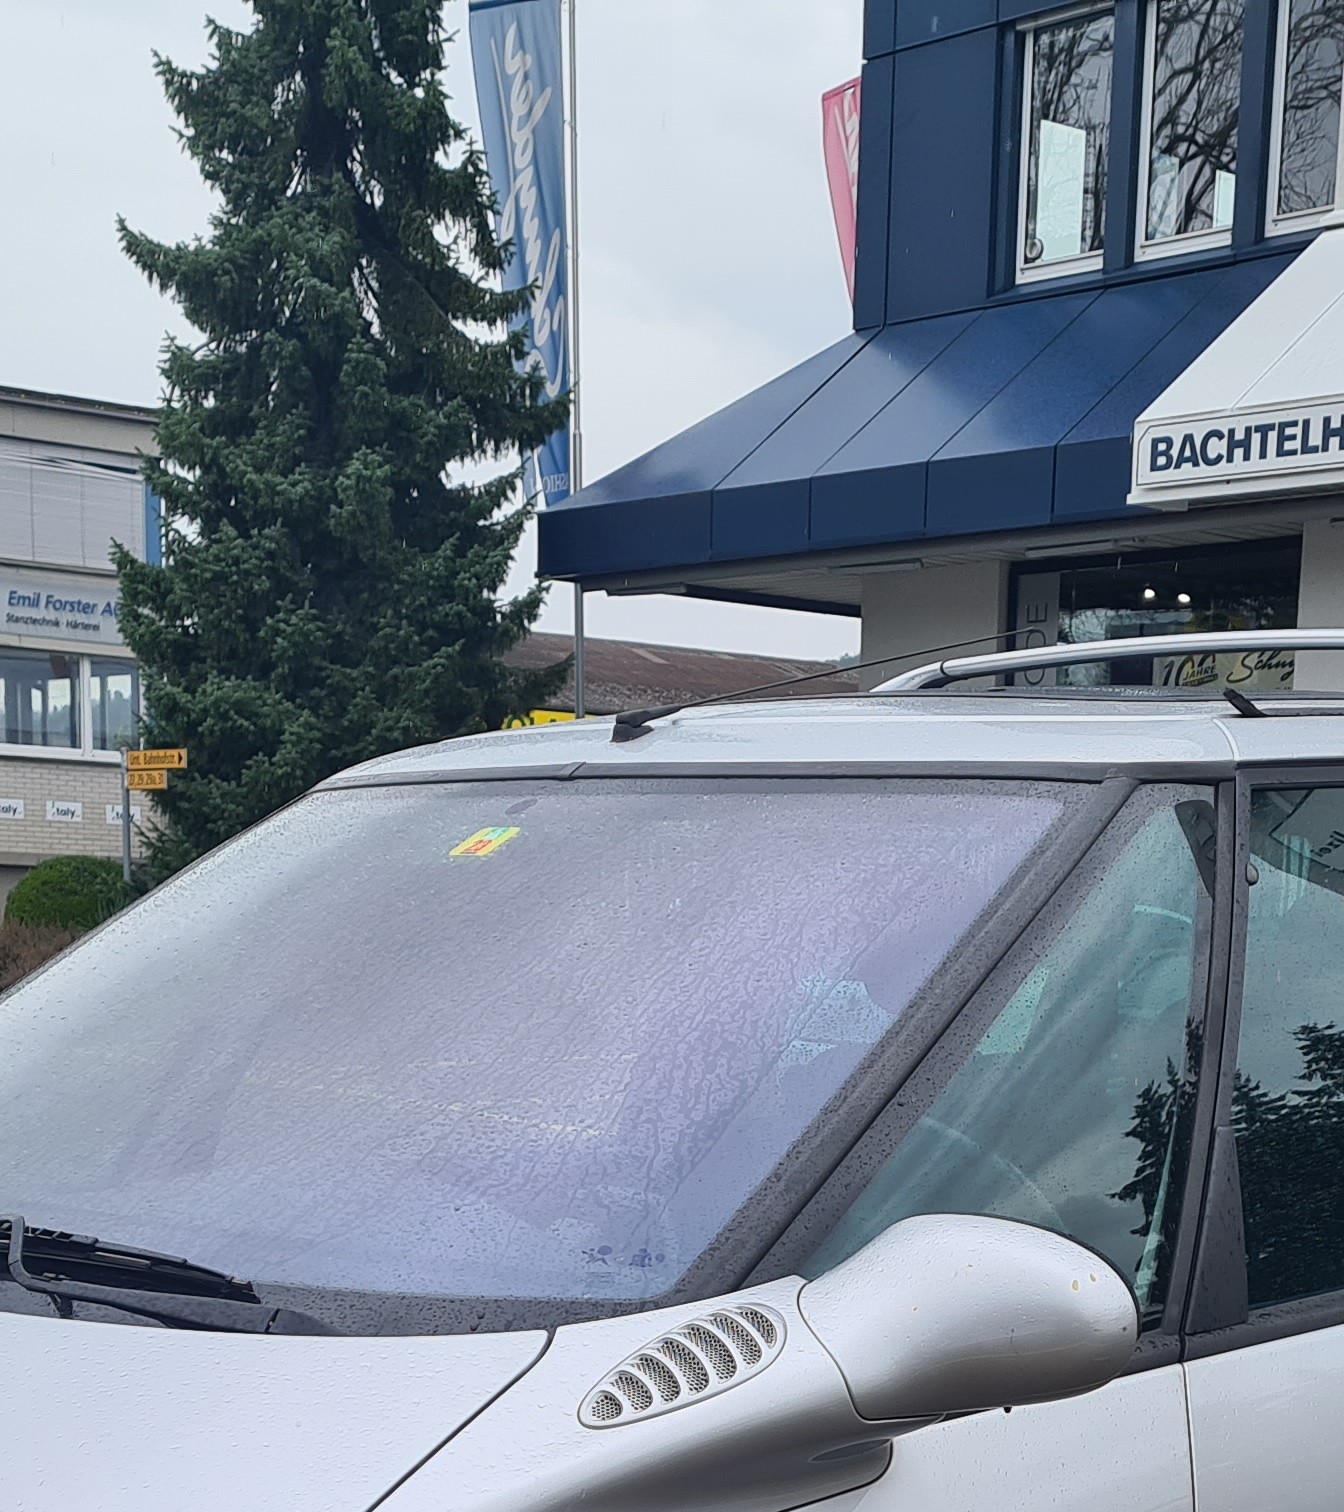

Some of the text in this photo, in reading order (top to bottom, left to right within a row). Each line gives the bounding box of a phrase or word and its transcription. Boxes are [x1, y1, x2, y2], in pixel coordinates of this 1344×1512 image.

[8, 590, 40, 608] Emil
[44, 595, 98, 614] Forster
[6, 612, 60, 628] Stanztechnik
